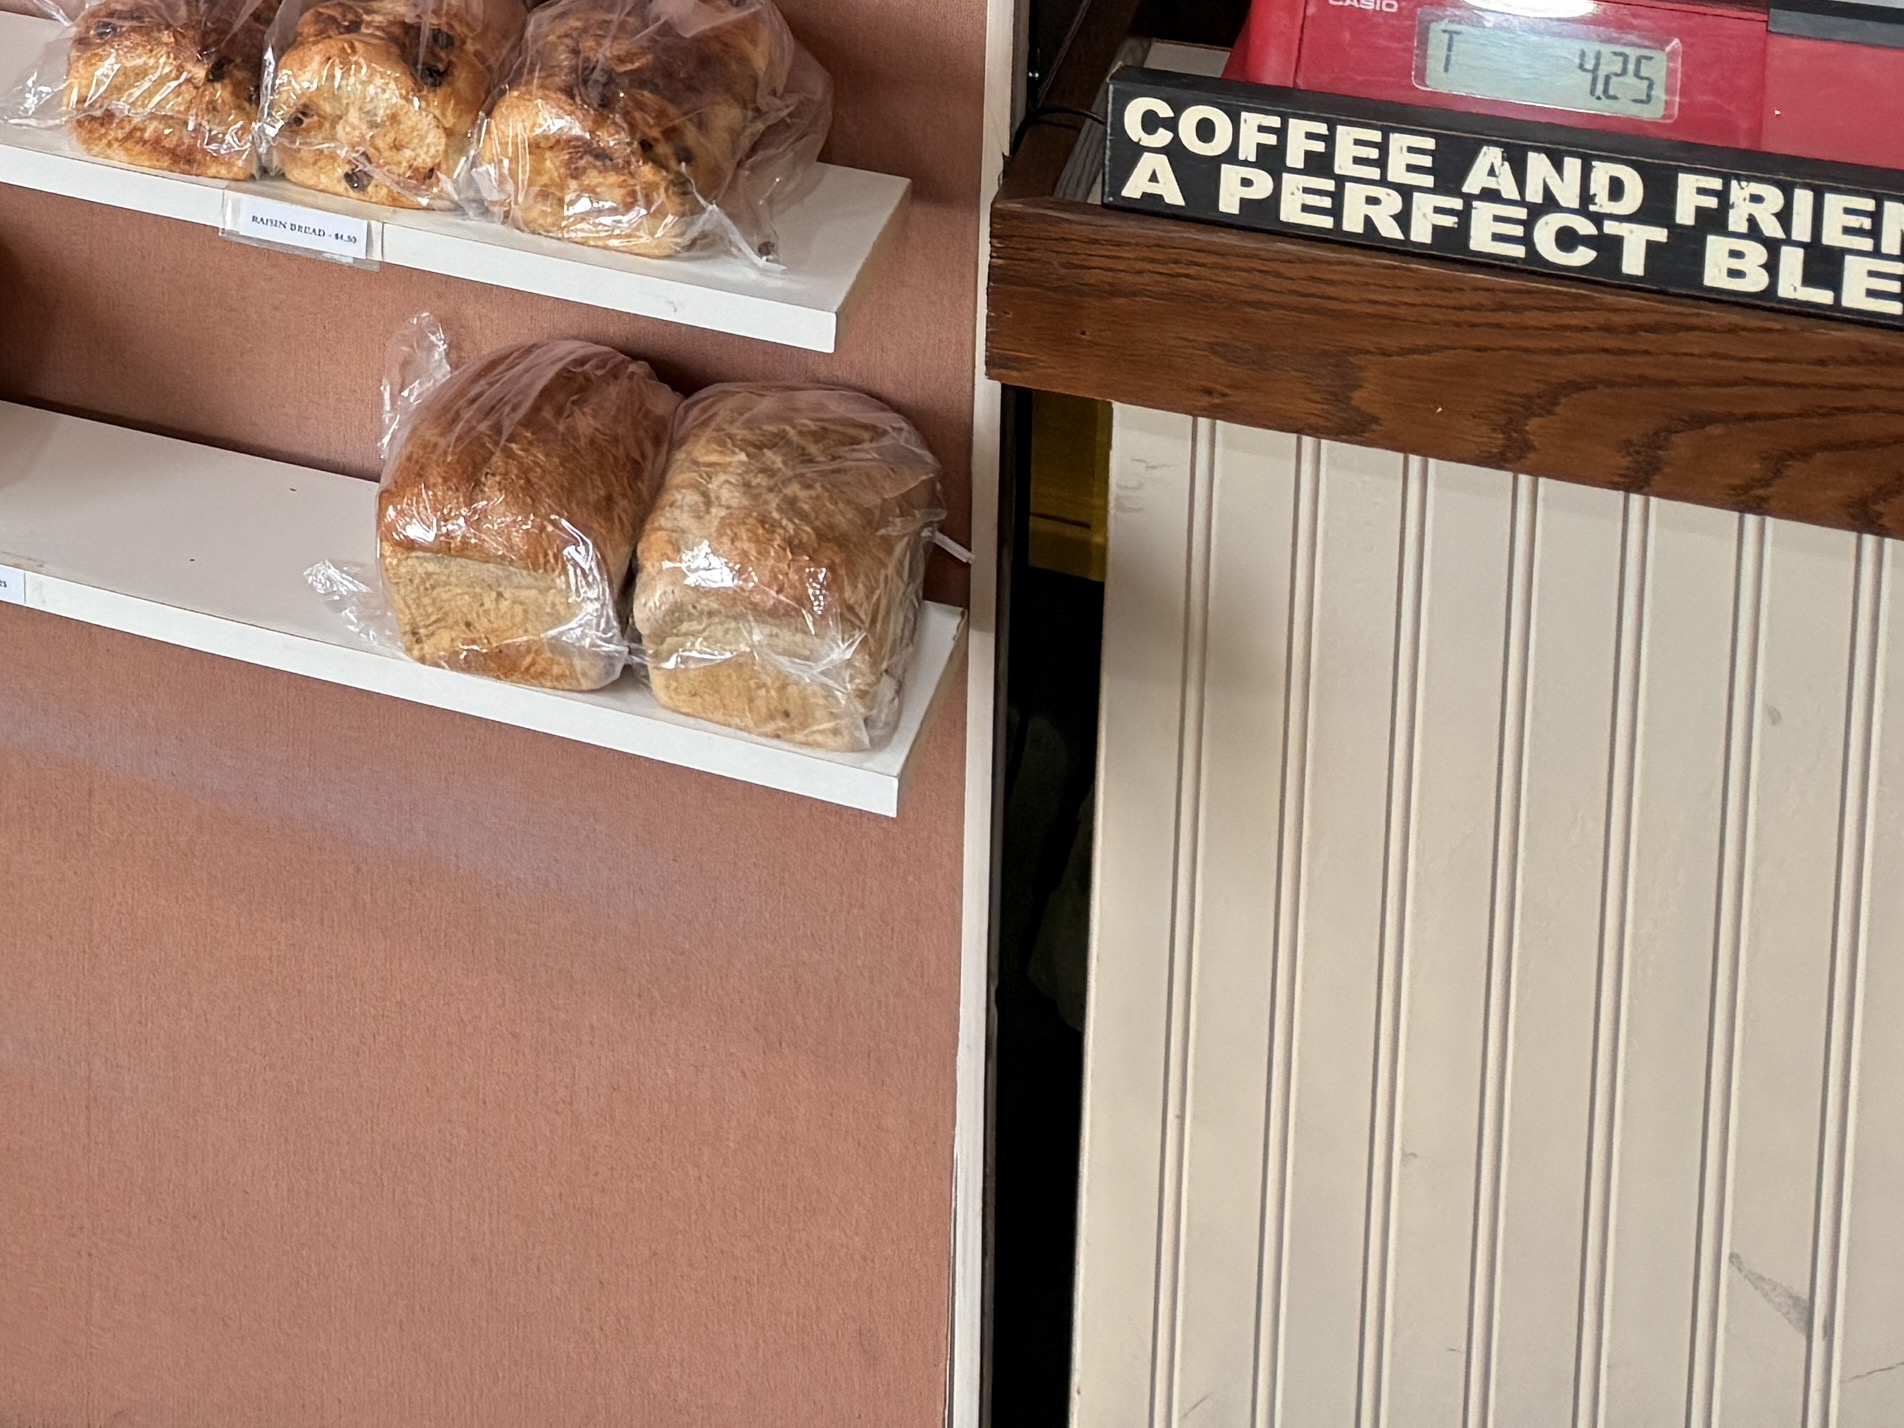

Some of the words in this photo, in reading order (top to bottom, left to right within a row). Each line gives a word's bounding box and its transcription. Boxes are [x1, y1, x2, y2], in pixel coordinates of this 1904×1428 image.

[1577, 46, 1655, 106] 4.25
[1123, 97, 1436, 188] COFFEE
[1462, 145, 1644, 216] AND
[252, 215, 287, 230] RAISIN
[290, 223, 325, 237] BREAD
[1121, 152, 1186, 207] A
[1219, 165, 1667, 276] PERFECT
